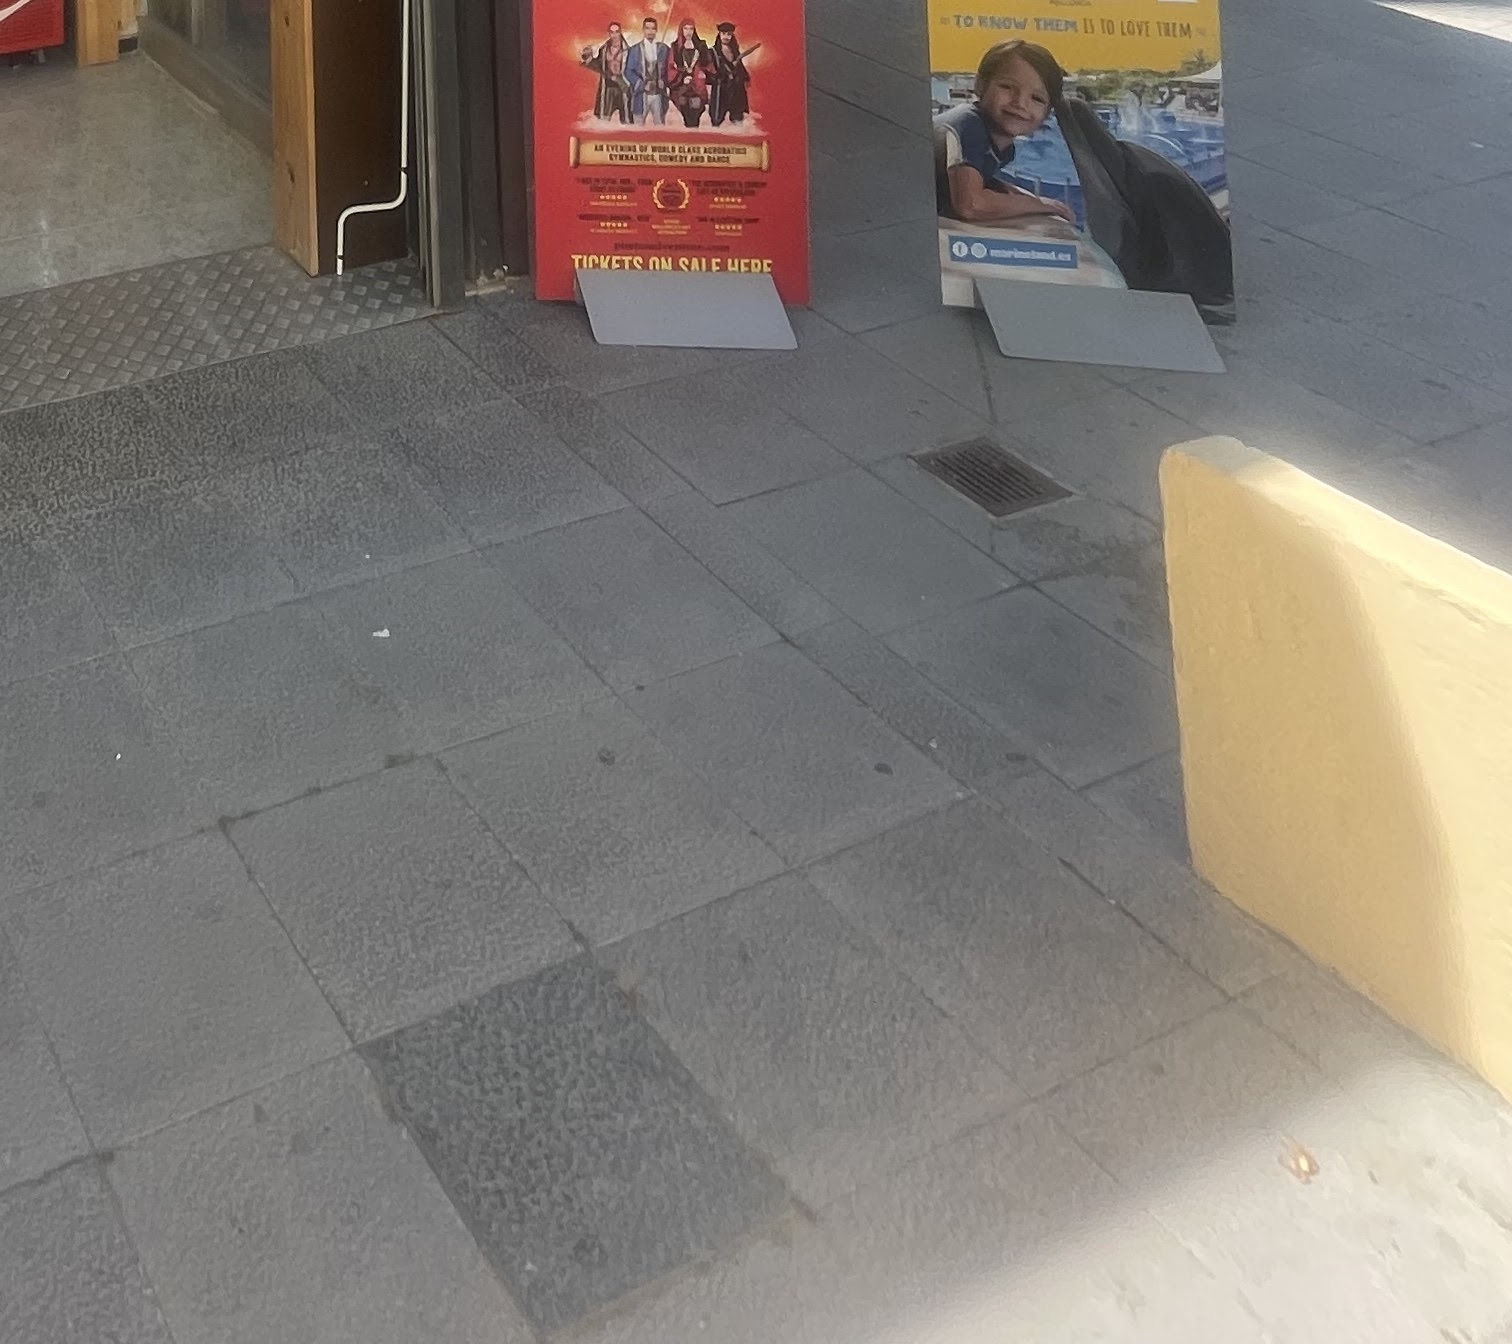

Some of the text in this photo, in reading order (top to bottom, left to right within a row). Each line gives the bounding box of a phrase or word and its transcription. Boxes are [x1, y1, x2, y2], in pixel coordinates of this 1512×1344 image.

[954, 15, 1193, 39] TO KNOW THEM IS TO LOVE THEM
[570, 255, 643, 271] TICKETS
